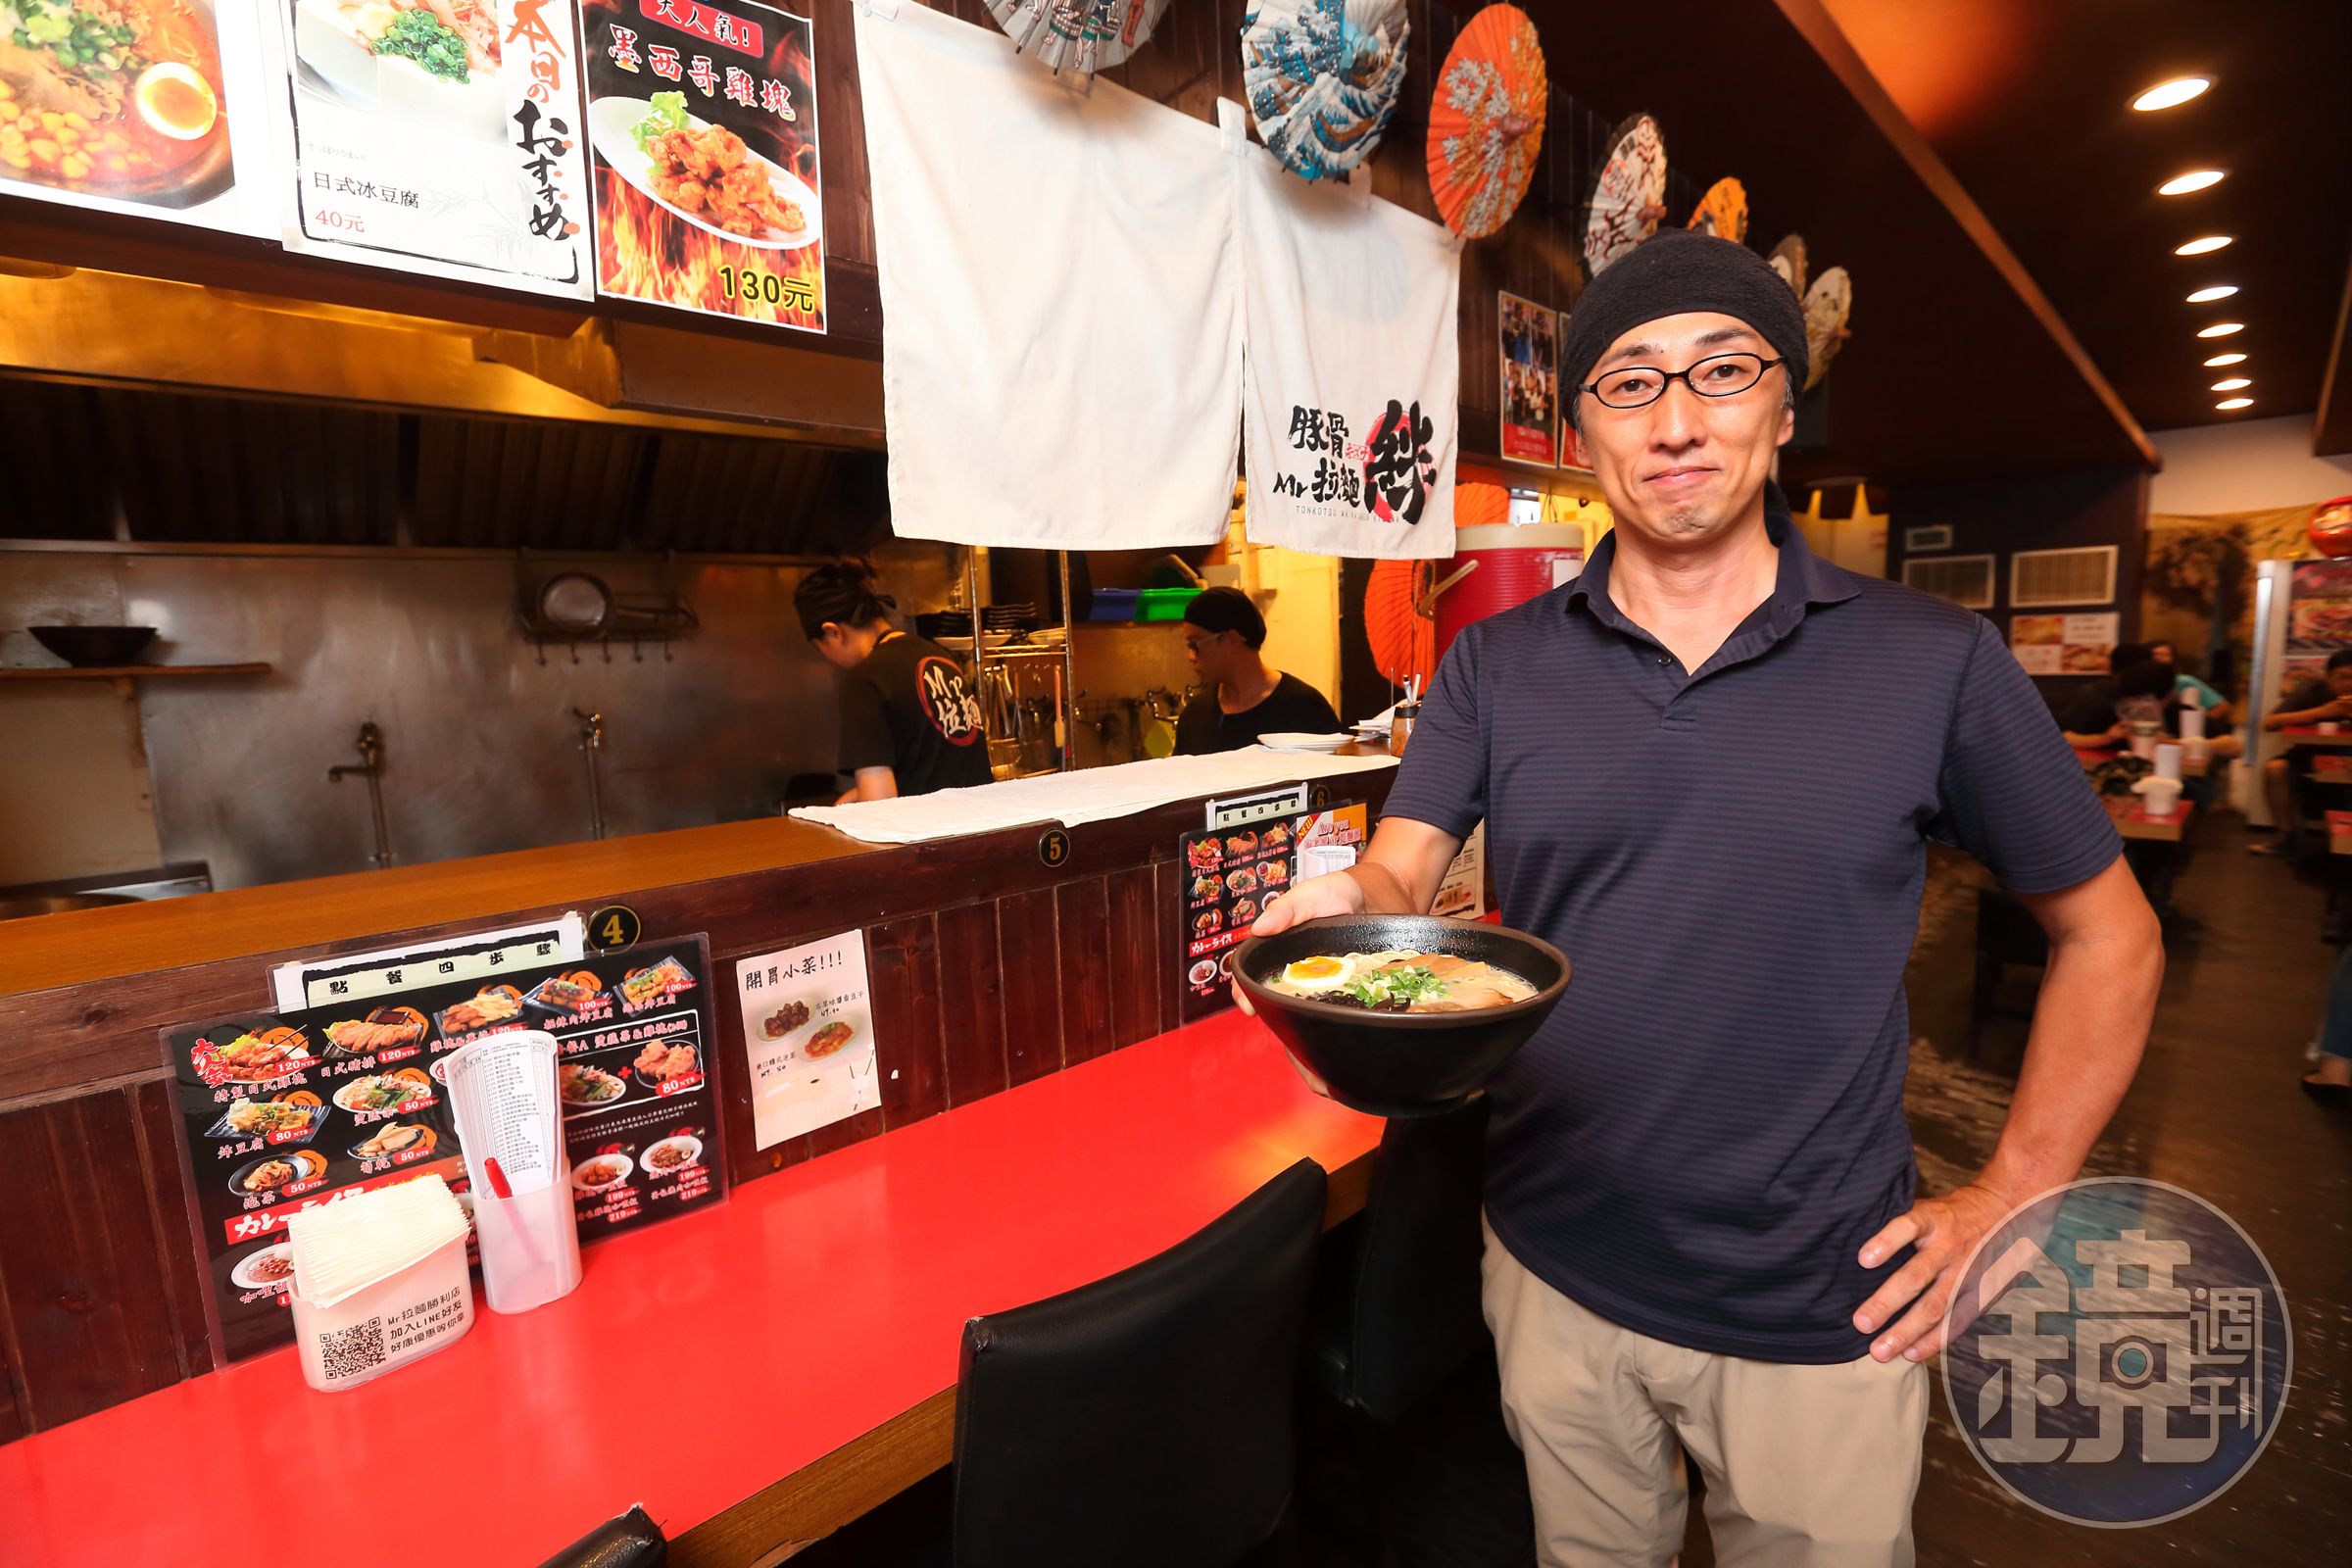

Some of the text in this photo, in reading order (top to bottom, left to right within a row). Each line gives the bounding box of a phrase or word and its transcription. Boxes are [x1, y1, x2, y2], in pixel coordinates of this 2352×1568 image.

[609, 24, 796, 122] 墨西哥雞塊
[314, 171, 419, 209] 日式冰豆腐
[316, 210, 365, 233] 40元
[718, 265, 814, 313] 130元
[1288, 405, 1349, 460] 豚骨
[1298, 816, 1313, 840] NEW
[1050, 837, 1061, 860] 5
[602, 913, 624, 945] 4
[746, 950, 843, 992] 開胃小菜!!!
[218, 1137, 265, 1159] 炸豆腐
[243, 1190, 275, 1210] 泡菜
[390, 1299, 463, 1341] 加入LINE好友
